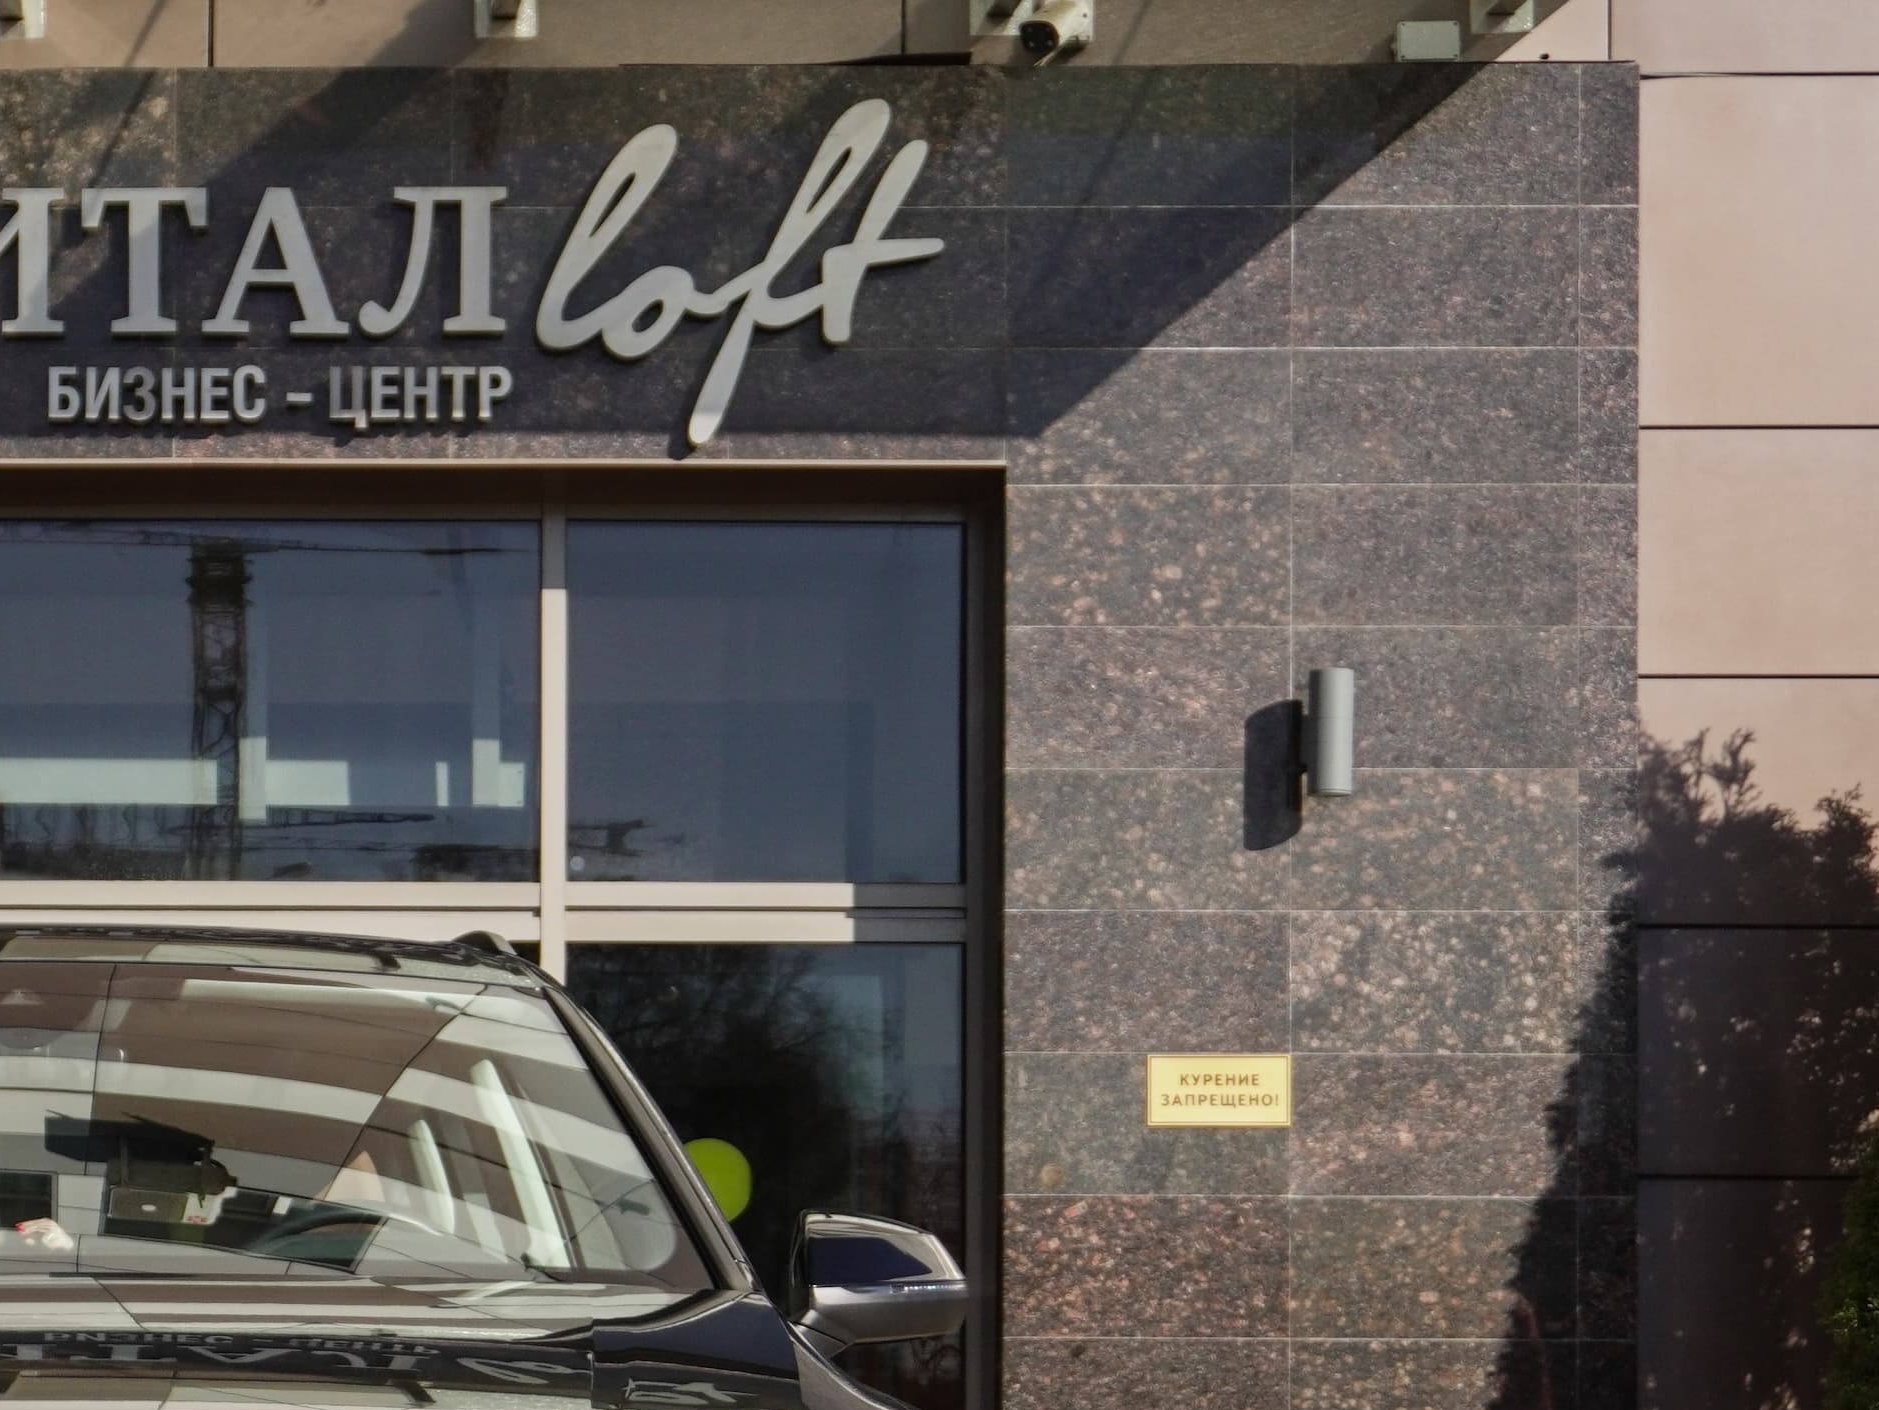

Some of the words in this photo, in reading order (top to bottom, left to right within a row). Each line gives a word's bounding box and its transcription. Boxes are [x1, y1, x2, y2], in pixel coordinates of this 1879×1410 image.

[536, 97, 945, 448] loft
[47, 364, 267, 424] БИЗНЕС
[328, 365, 514, 430] ЦЕНТР
[1179, 1073, 1260, 1087] КУРЕНИЕ
[1161, 1093, 1279, 1108] ЗАПРЕЩЕНО!
